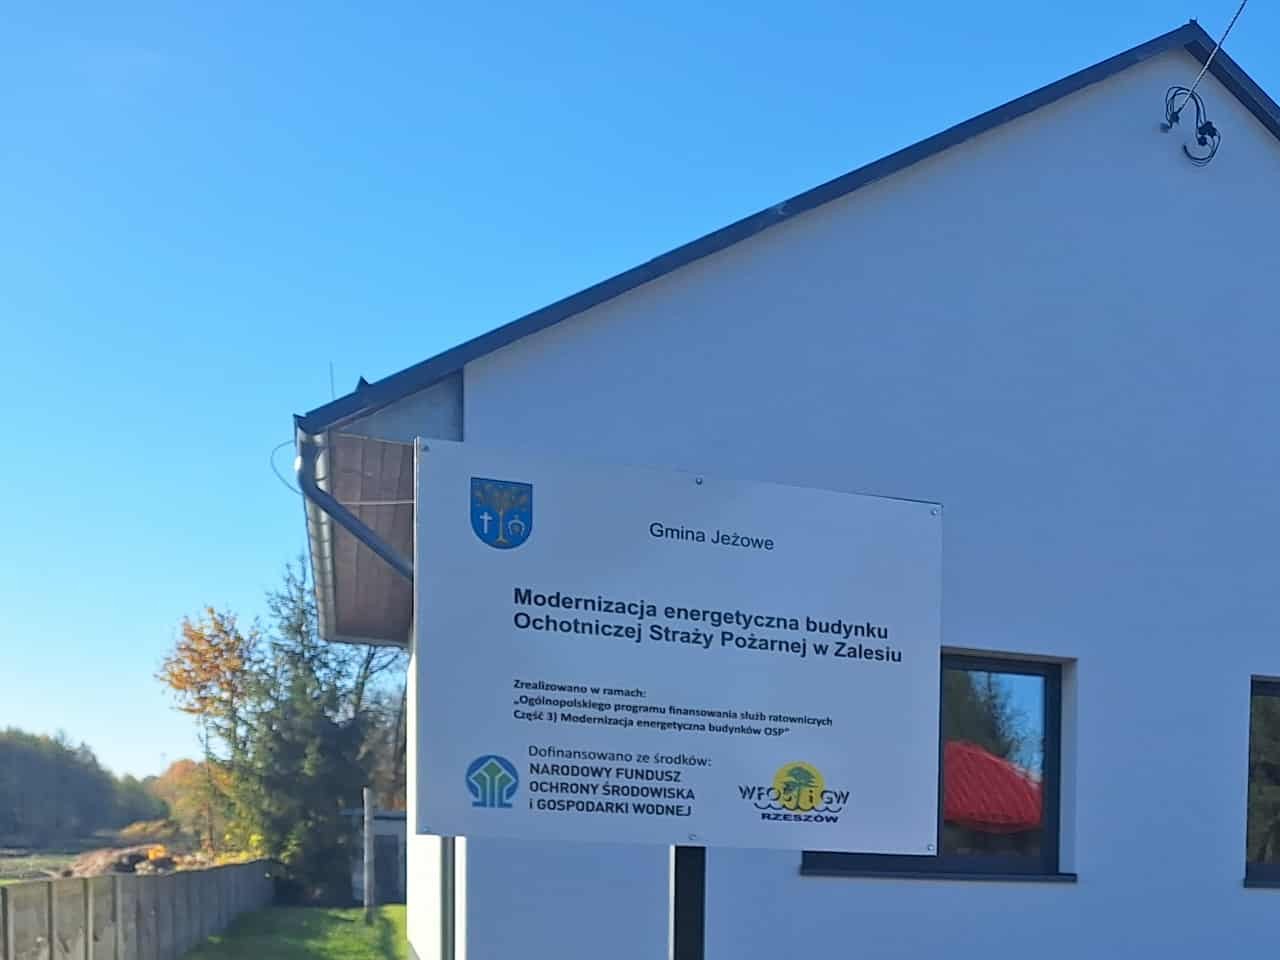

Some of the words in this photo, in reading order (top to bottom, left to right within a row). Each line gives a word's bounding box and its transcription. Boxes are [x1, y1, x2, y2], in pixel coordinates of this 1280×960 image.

[649, 522, 705, 542] Gmina
[711, 529, 775, 550] Jeżowe
[513, 587, 657, 620] Modernizacja
[664, 605, 799, 629] energetyczna
[806, 616, 888, 639] budynku
[513, 612, 642, 643] Ochotniczej
[649, 624, 714, 649] Straży
[721, 631, 807, 658] Pożarnej
[813, 643, 829, 656] w
[834, 642, 902, 663] Zalesiu
[513, 680, 587, 694] Zrealizowano
[590, 686, 600, 694] w
[602, 688, 648, 698] ramach:
[513, 710, 544, 722] Część
[546, 712, 557, 723] 3)
[560, 713, 634, 727] Modernizacja
[636, 719, 706, 732] energetyczna
[708, 723, 762, 735] budynków
[614, 703, 666, 715] programu
[669, 706, 738, 719] finansowania
[768, 714, 833, 727] ratowniczych
[528, 745, 633, 762] Dofinansowano
[636, 754, 650, 763] ze
[653, 752, 712, 767] środków:
[529, 763, 612, 778] NARODOWY
[616, 768, 681, 782] FUNDUSZ
[529, 781, 599, 796] OCHRONY
[602, 781, 696, 800] ŚRODOWISKA
[536, 799, 629, 814] GOSPODARKI
[632, 803, 692, 816] WODNEJ
[761, 812, 839, 823] RZESZÓW
